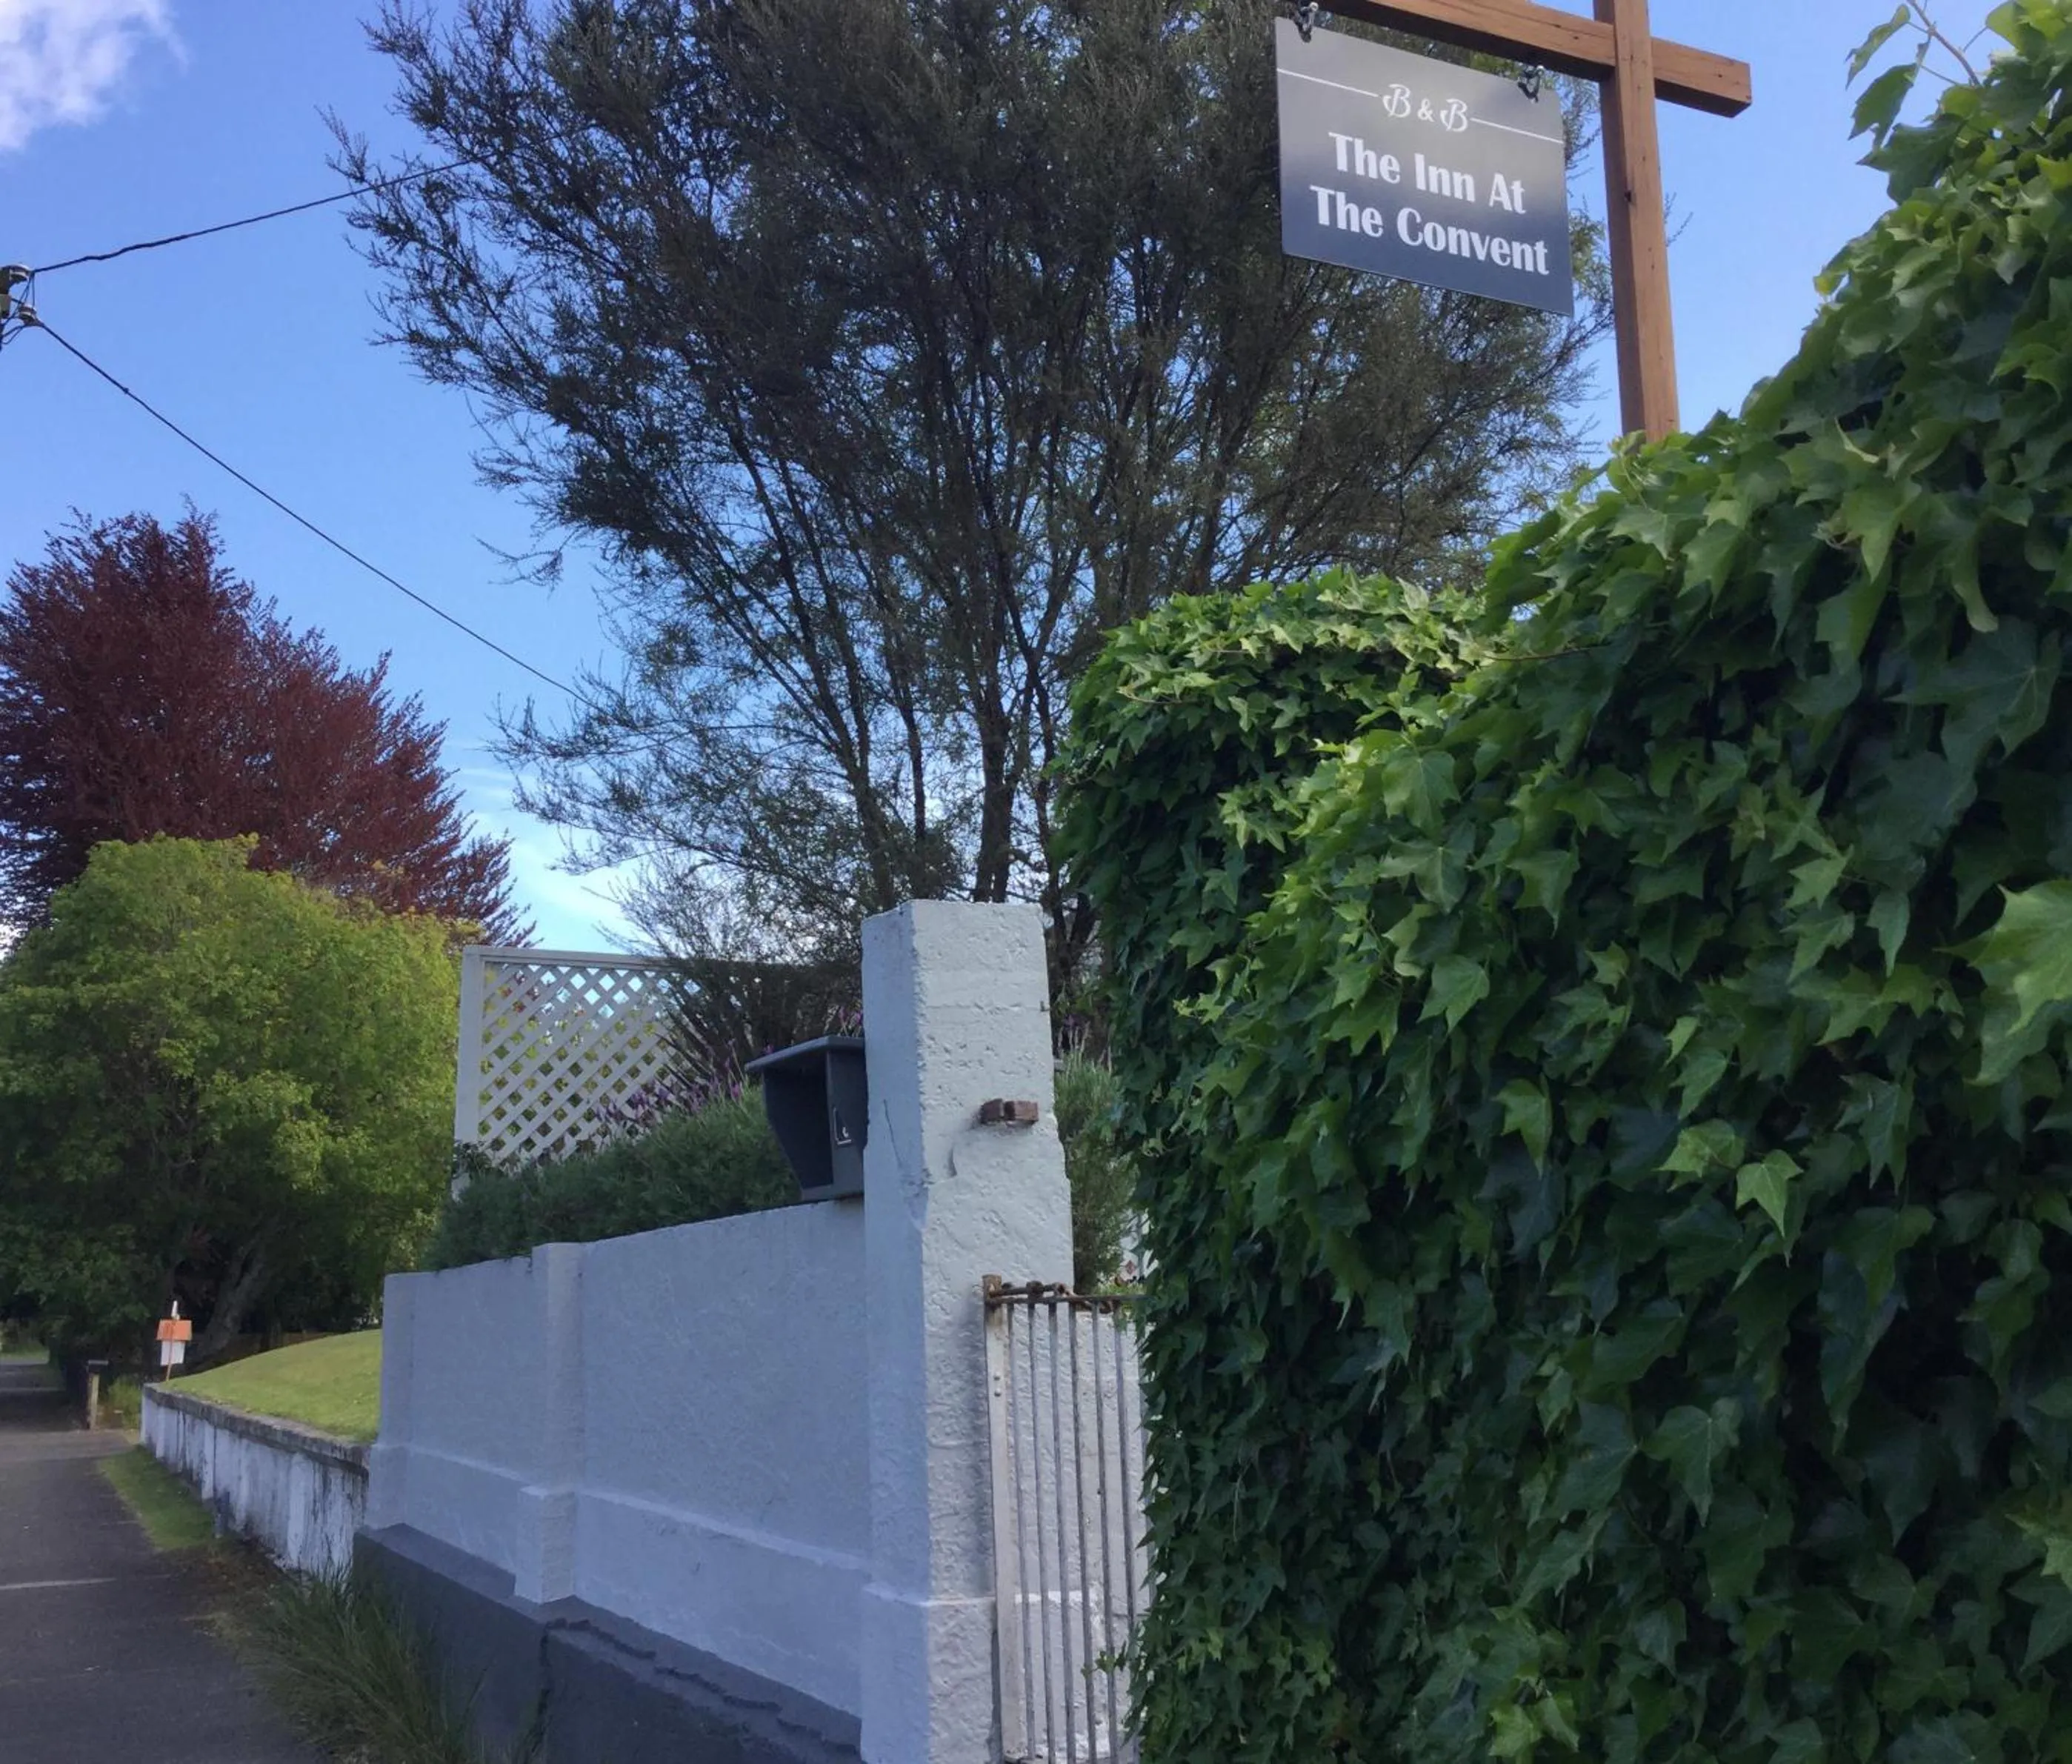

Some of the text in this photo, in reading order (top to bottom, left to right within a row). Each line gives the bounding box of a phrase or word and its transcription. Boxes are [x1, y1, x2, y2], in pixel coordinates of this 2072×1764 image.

[1328, 132, 1526, 215] The Inn At
[1310, 184, 1550, 276] The Convent
